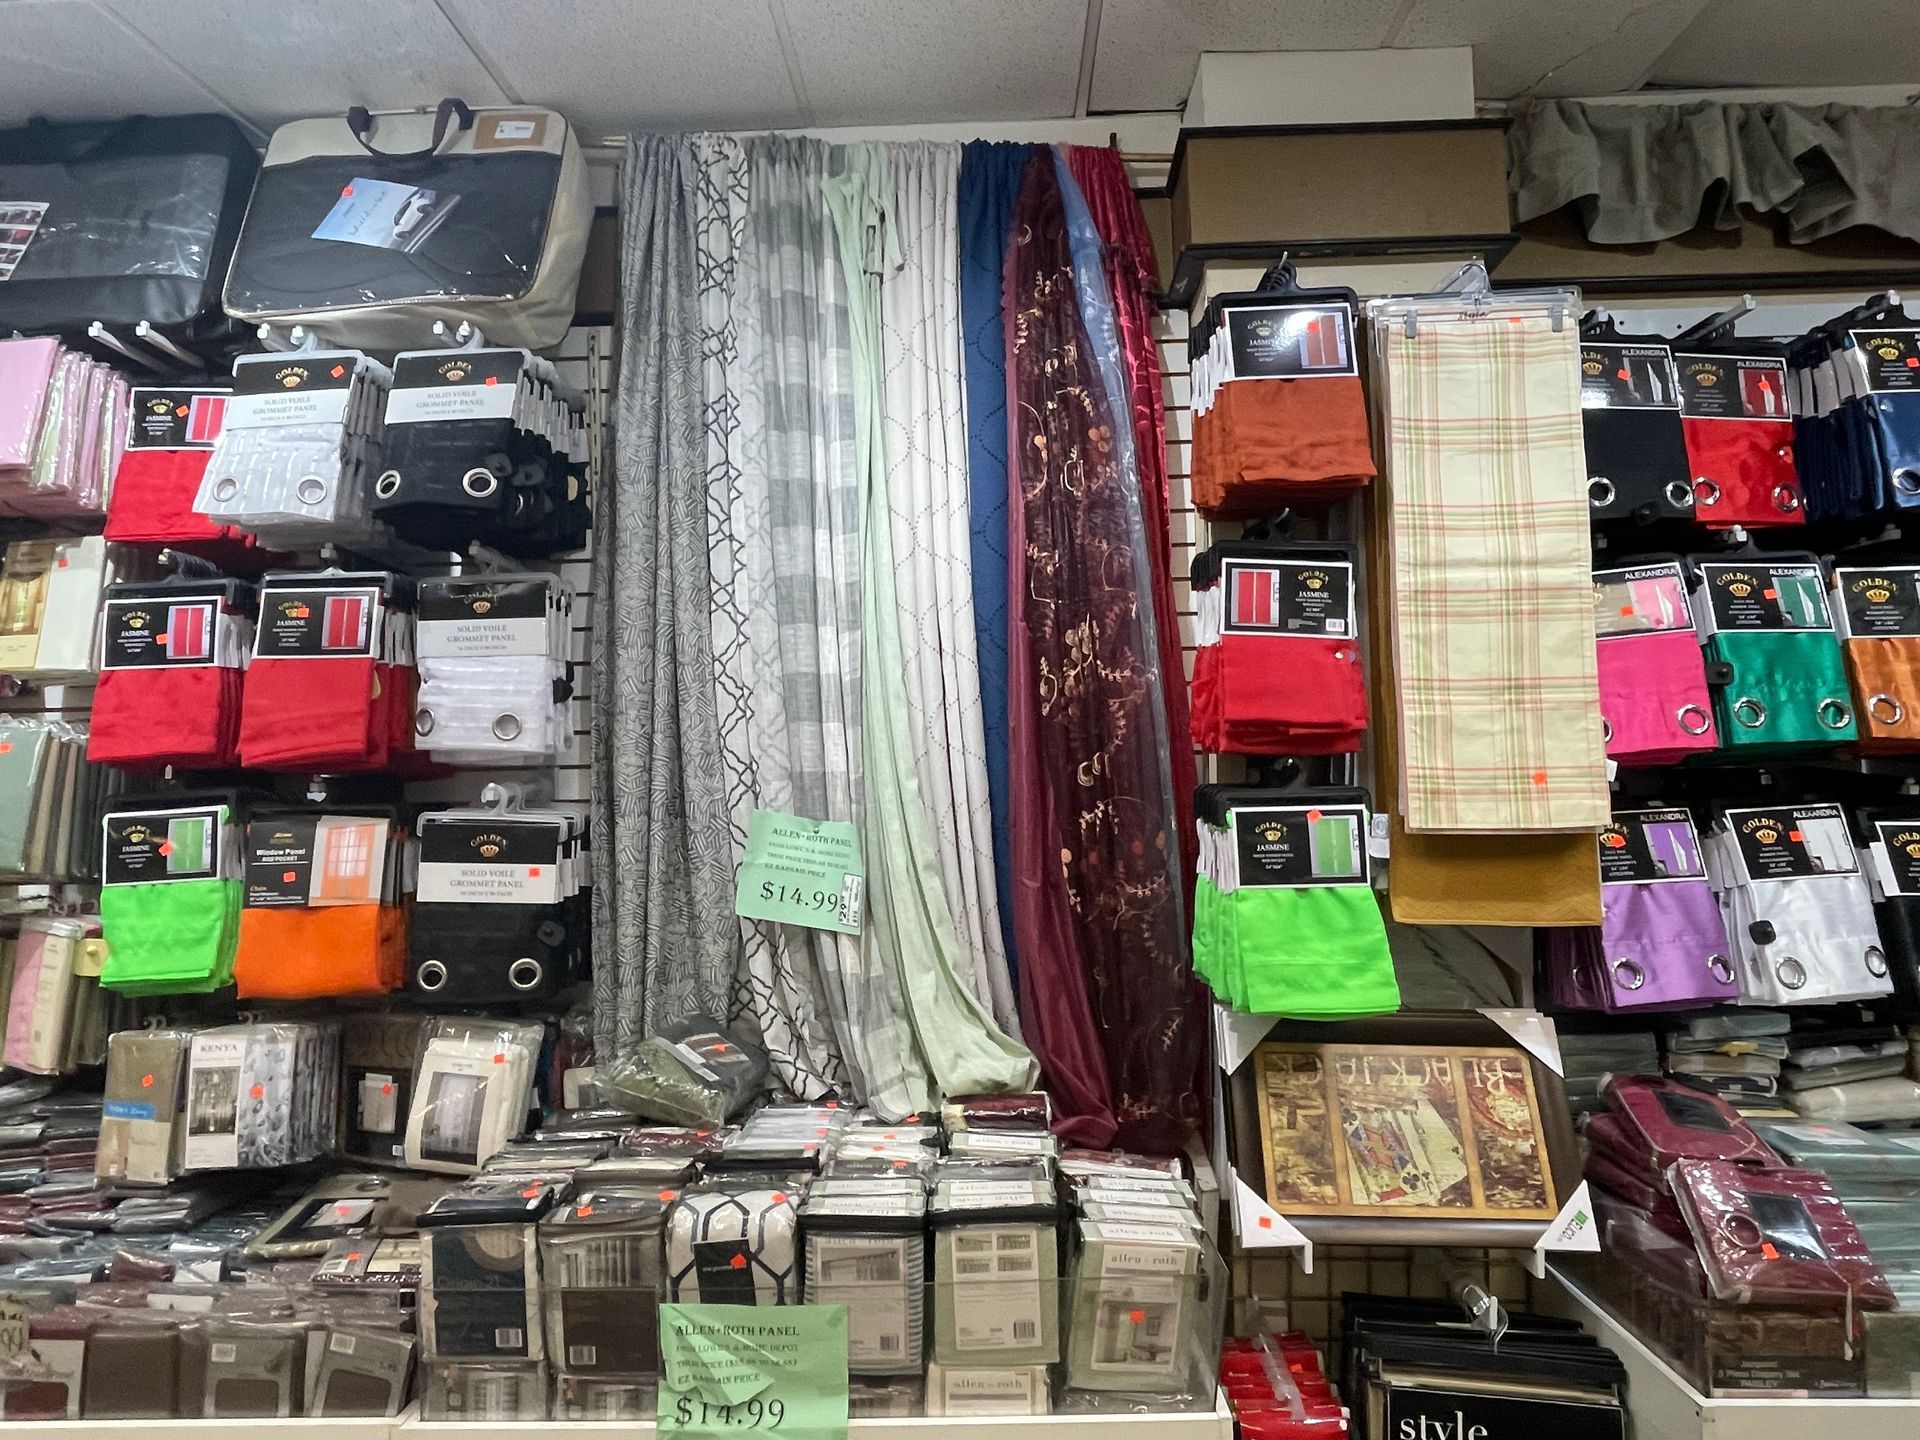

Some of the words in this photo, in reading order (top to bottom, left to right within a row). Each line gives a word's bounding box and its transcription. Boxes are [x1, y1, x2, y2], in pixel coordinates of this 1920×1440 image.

[1736, 360, 1783, 368] ALEXANDRA
[1298, 570, 1329, 584] GOLDEN
[1625, 568, 1677, 579] ALEXANDRA
[1715, 572, 1759, 588] GOLDEN
[1852, 577, 1898, 594] GOLDEN
[447, 635, 490, 643] GROMMET
[492, 634, 517, 642] PANEL
[1640, 813, 1687, 821] ALEXANDRA
[1793, 808, 1840, 818] ALEXANDRA
[1254, 821, 1288, 835] GOLDEN
[1742, 817, 1784, 835] GOLDEN
[830, 837, 852, 848] PANEL
[1892, 832, 1920, 847] GOLD
[1256, 844, 1290, 852] JASMINE
[489, 870, 515, 878] VOILE
[807, 870, 827, 879] PRICE
[450, 880, 496, 888] GROMMET
[497, 880, 524, 888] PANEL
[760, 880, 838, 913] $14.99
[200, 1044, 238, 1052] KENYA
[1111, 1252, 1141, 1263] allen
[1153, 1254, 1178, 1265] roth
[759, 1325, 799, 1337] PANEL
[677, 1374, 690, 1384] EZ
[733, 1373, 761, 1383] PRICE
[953, 1379, 986, 1389] allen
[997, 1379, 1023, 1389] roth
[674, 1394, 785, 1431] $14.99
[1400, 1410, 1488, 1440] style
